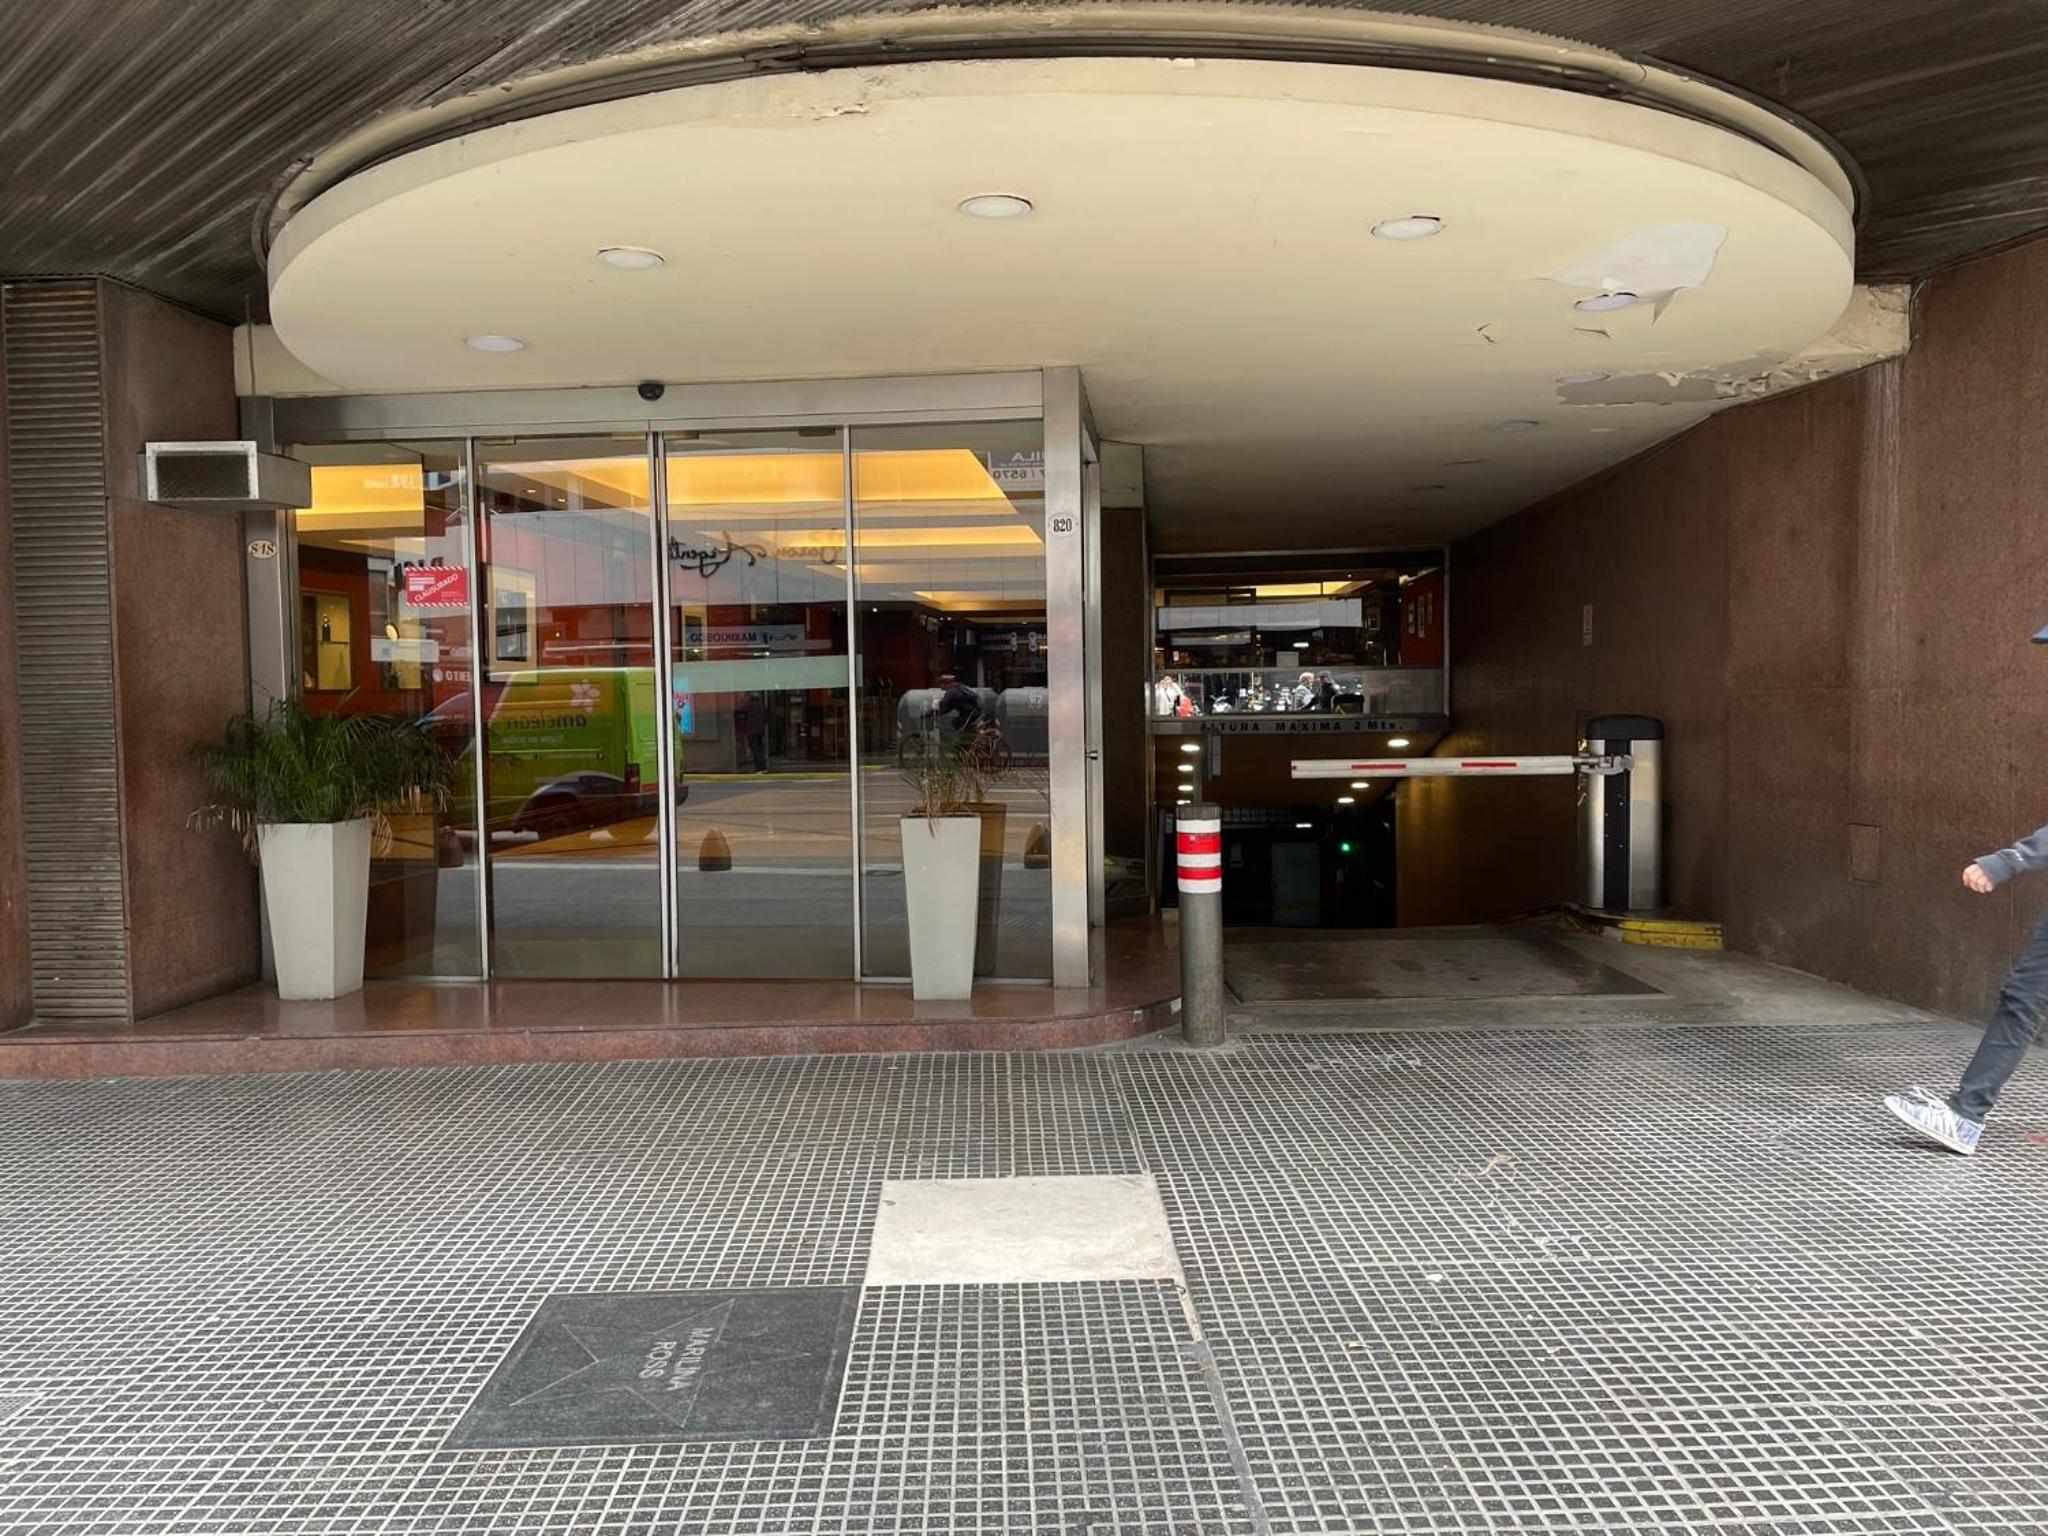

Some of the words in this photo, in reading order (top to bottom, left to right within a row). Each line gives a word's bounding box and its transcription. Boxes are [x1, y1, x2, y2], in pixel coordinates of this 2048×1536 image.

[1053, 518, 1073, 532] 820
[1275, 722, 1342, 732] MAXIMA
[639, 1341, 677, 1379] ROSS
[667, 1327, 715, 1391] MARILINA
